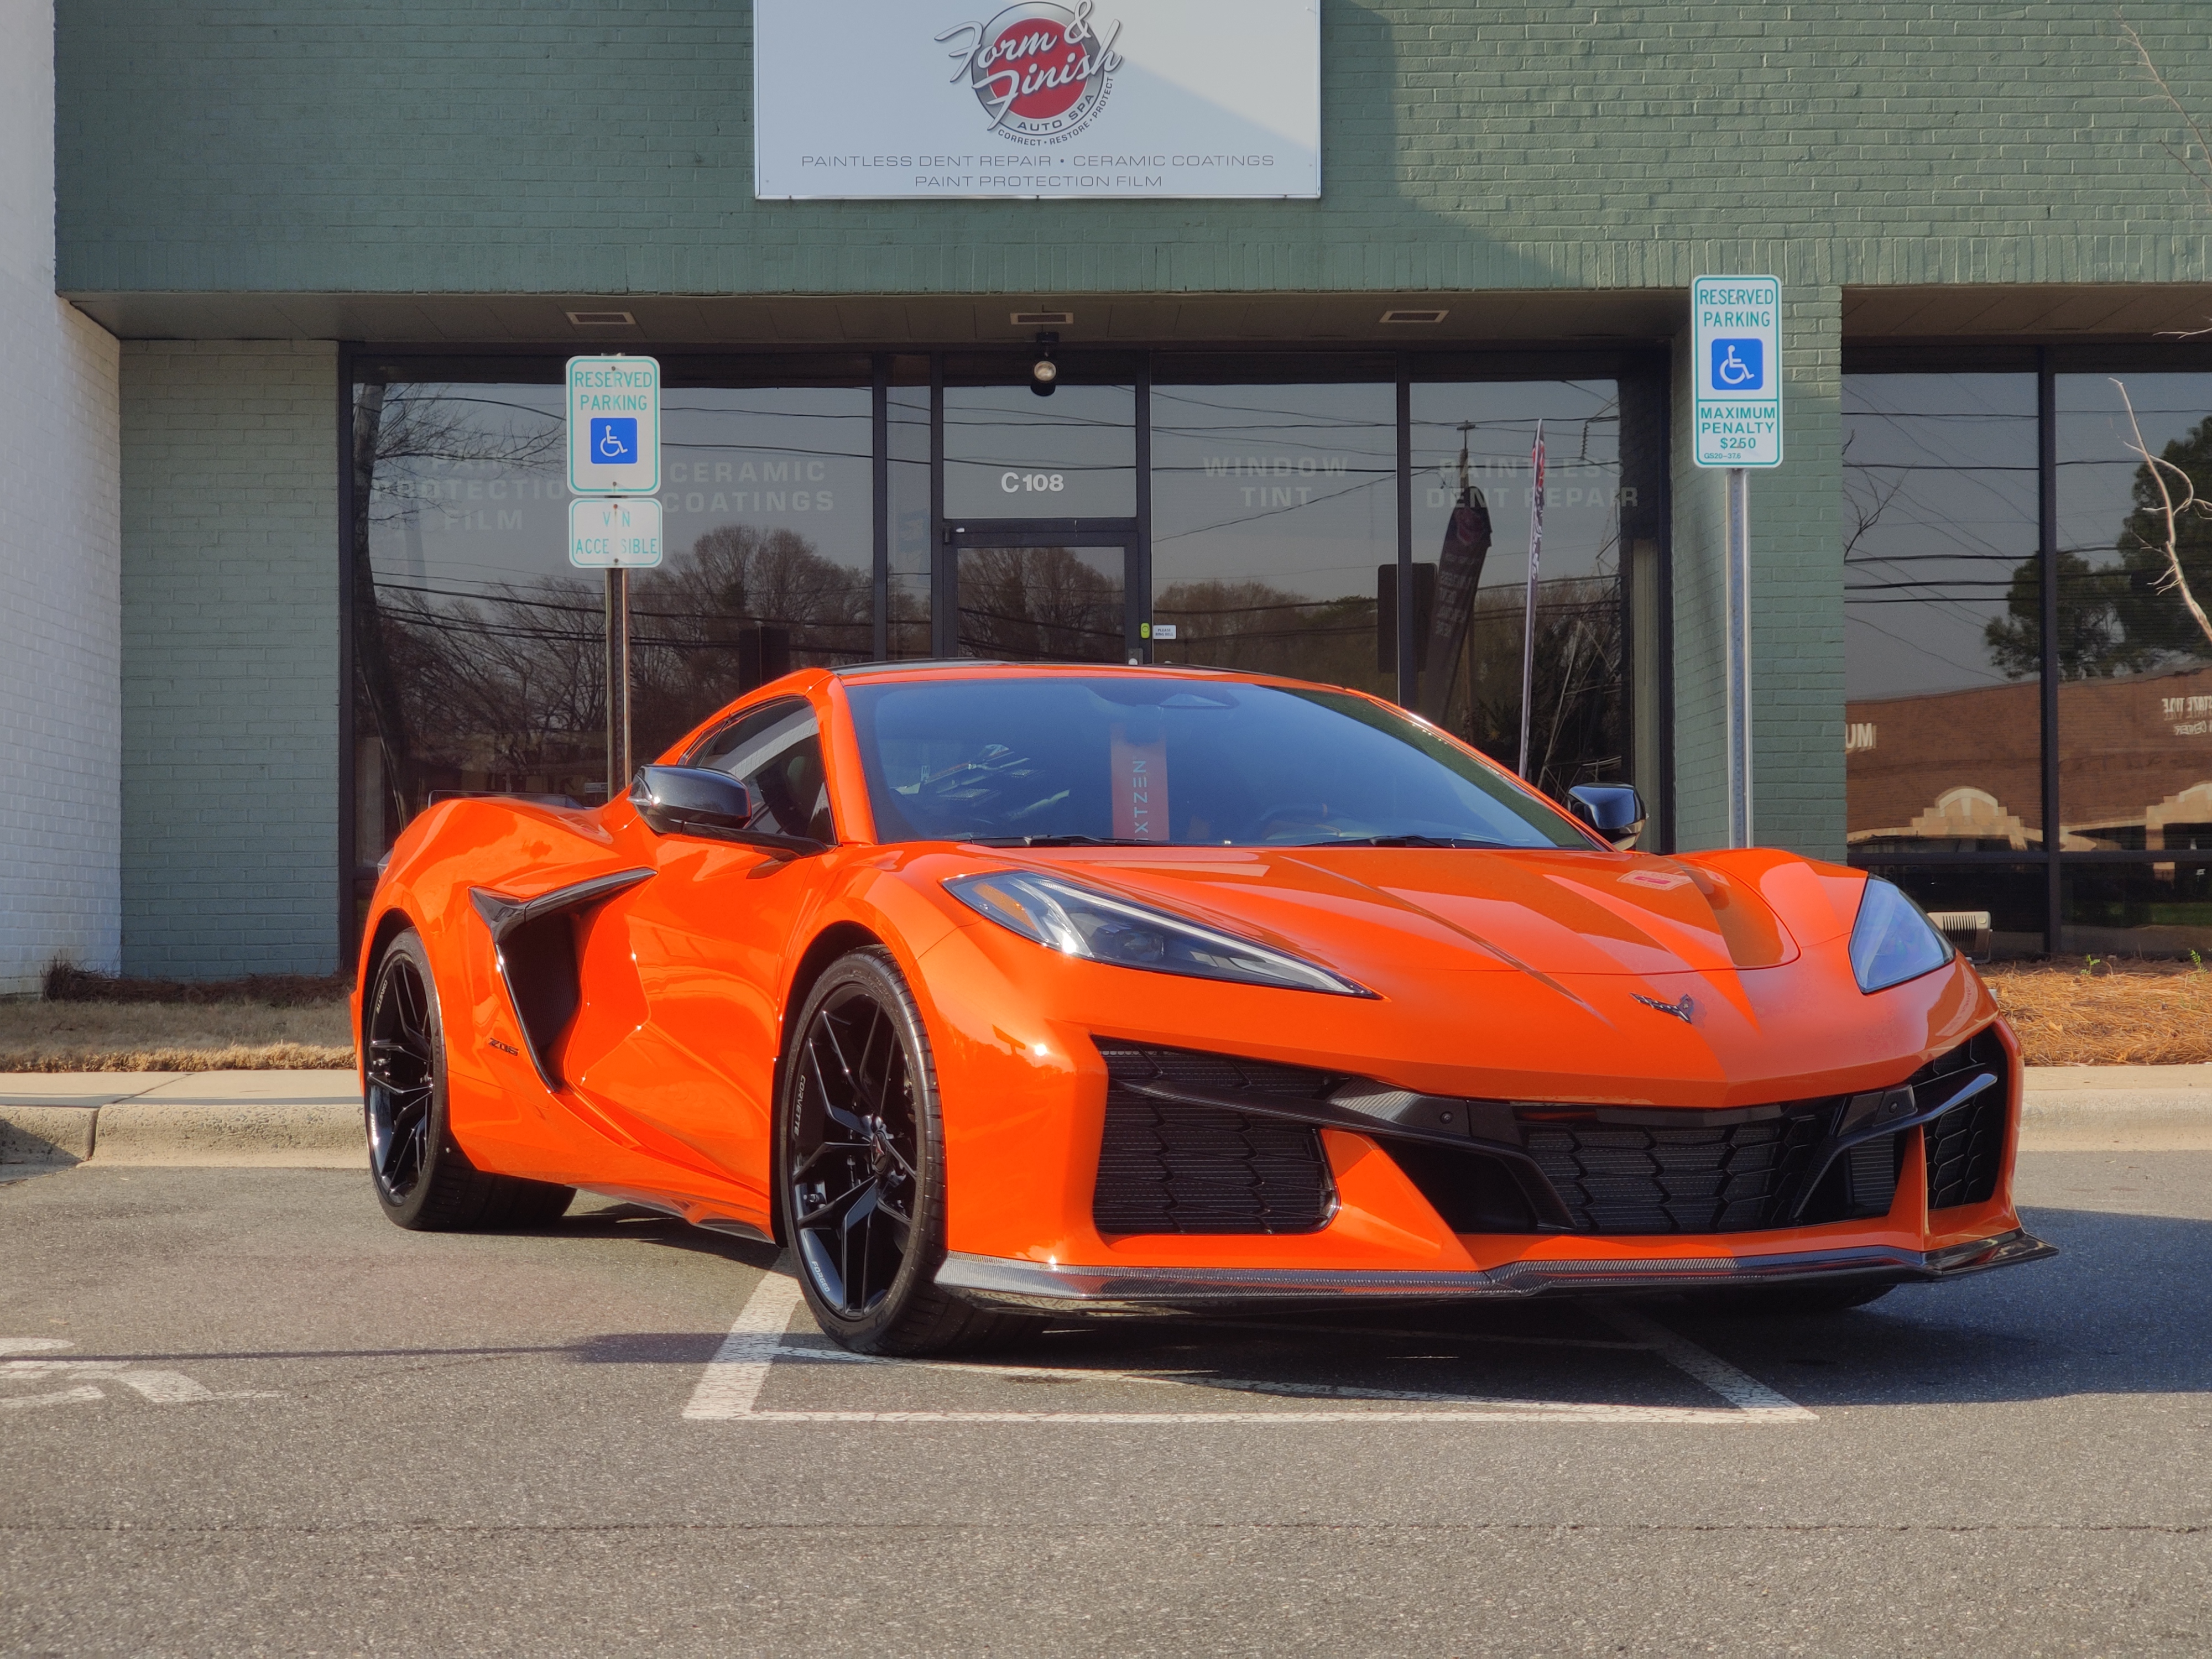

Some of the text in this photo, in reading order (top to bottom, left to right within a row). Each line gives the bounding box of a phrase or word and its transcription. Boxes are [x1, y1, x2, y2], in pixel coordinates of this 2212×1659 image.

[934, 0, 1093, 83] Form &
[972, 19, 1122, 131] Finish
[998, 77, 1114, 146] CORRECT RESTORE PROTECT
[1017, 94, 1094, 132] AUTO SPA
[802, 155, 1274, 166] PAINTLESS DENT REPAIR CERAMIC COATINGS
[915, 176, 1162, 187] PAINT PROTECTION FILM
[1700, 289, 1773, 305] RESERVED
[1704, 311, 1770, 327] PARKING
[575, 372, 652, 387] RESERVED
[580, 394, 647, 410] PARKING
[1701, 407, 1775, 419] MAXIMUM
[1702, 422, 1775, 434] PENALTY
[1720, 437, 1756, 450] $250
[670, 461, 825, 483] CERAMIC
[1203, 457, 1348, 477] WINDOW
[373, 479, 565, 499] PROTECTIO
[1001, 472, 1064, 493] C 108
[662, 491, 833, 513] COATINGS
[1240, 486, 1312, 507] TINT
[1426, 487, 1509, 508] DENT
[445, 509, 523, 530] FILM
[603, 512, 630, 527] VN
[576, 539, 657, 554] ACCESIBLE
[1133, 760, 1149, 841] XTZEN
[488, 1037, 519, 1056] Z06
[794, 1074, 806, 1136] CORVETTE
[811, 1261, 831, 1292] FORGED
